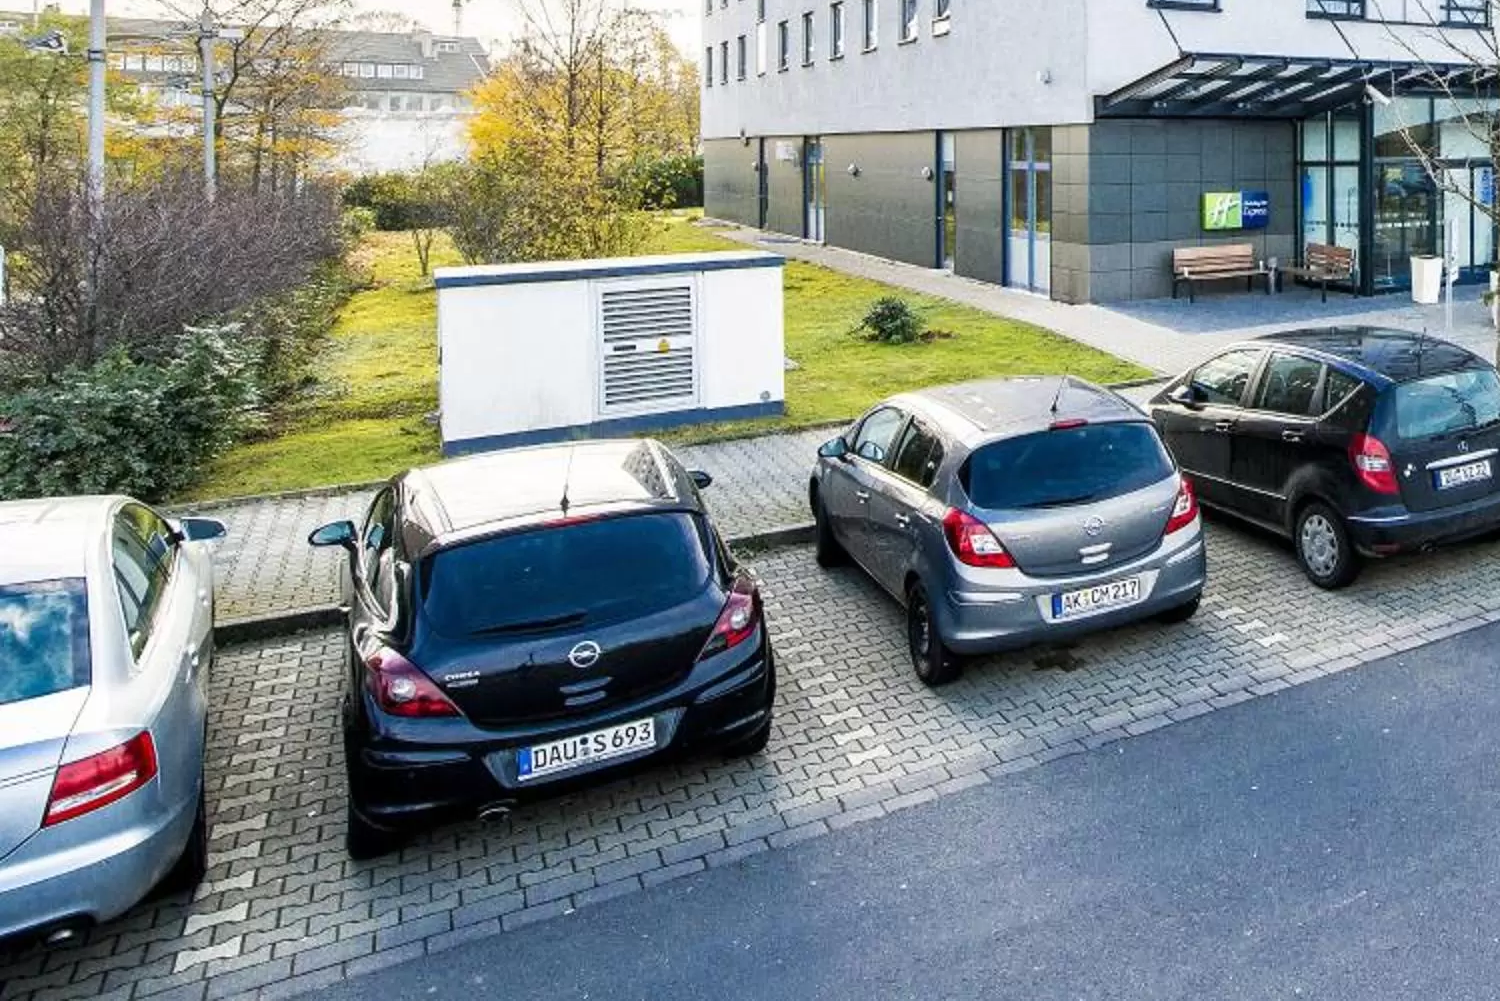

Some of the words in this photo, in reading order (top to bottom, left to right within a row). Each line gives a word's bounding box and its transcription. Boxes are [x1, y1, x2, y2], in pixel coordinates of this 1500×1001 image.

[1064, 593, 1081, 610] AK
[1091, 586, 1109, 604] CM
[1111, 580, 1137, 599] 217
[533, 740, 577, 769] DAU
[593, 734, 607, 753] S
[611, 722, 651, 748] 693
